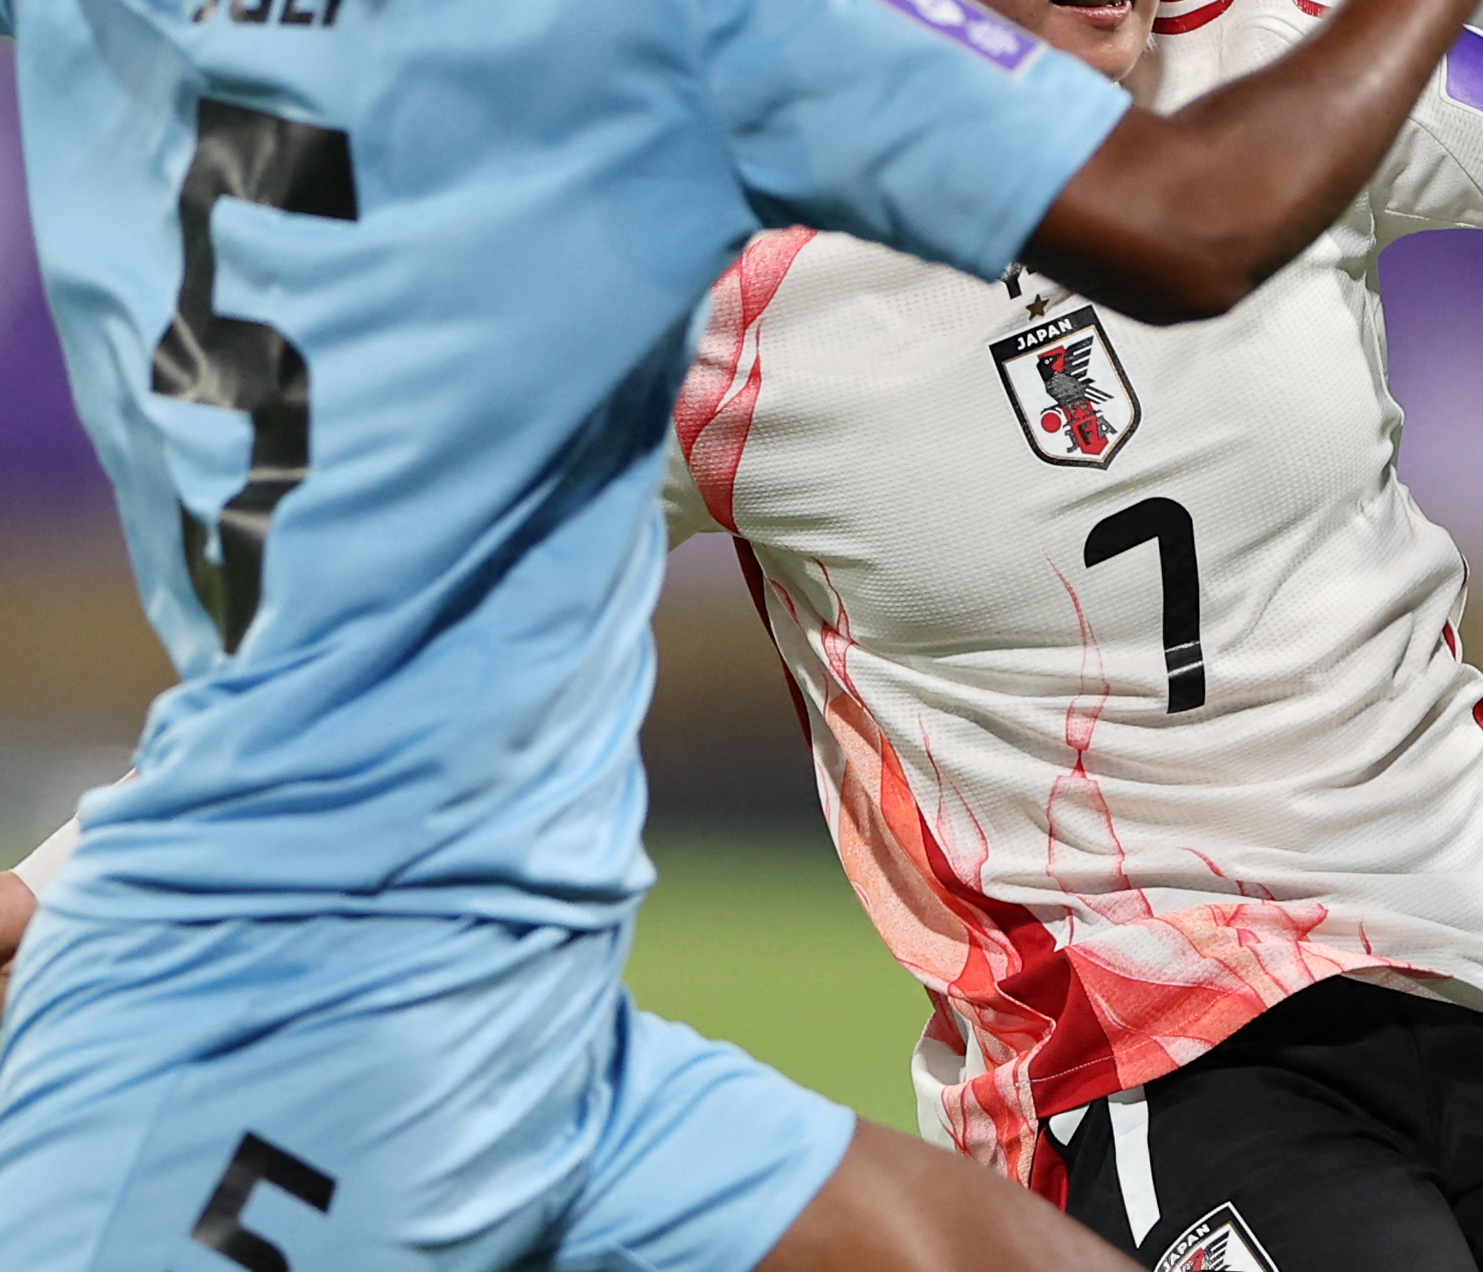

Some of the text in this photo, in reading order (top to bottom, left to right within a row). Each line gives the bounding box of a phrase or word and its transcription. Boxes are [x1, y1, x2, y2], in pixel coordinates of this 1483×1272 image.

[152, 96, 359, 655] 5
[1017, 318, 1073, 350] JAPAN
[1063, 415, 1118, 453] JFA
[1083, 496, 1206, 713] 7
